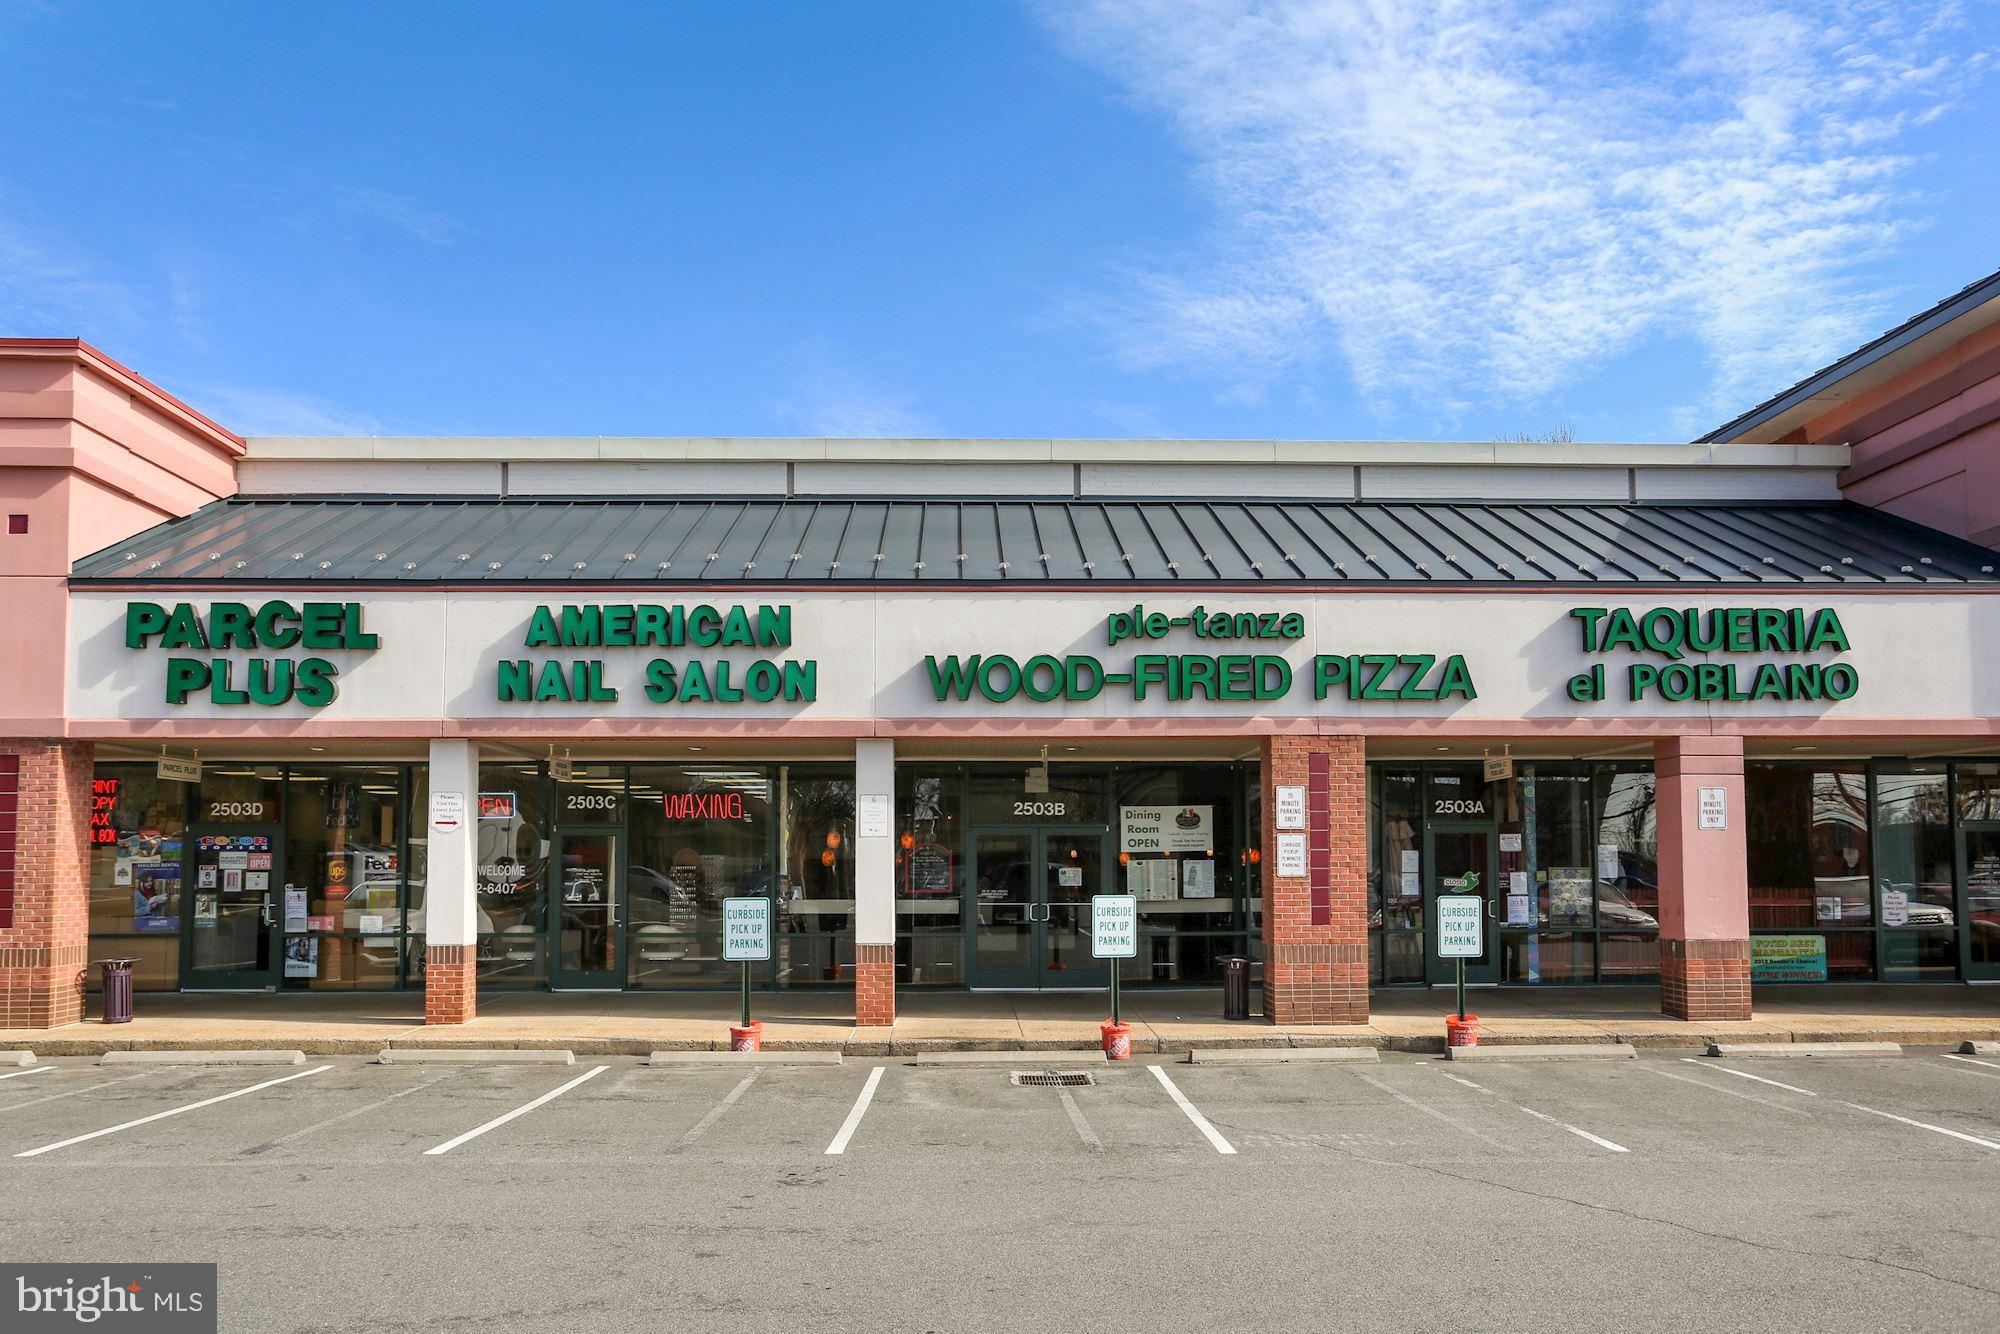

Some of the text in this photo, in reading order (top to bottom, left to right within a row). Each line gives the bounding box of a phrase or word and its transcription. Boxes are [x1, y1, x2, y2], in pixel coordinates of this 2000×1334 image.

[126, 601, 381, 650] PARCEL
[524, 604, 793, 648] AMERICAN
[1109, 604, 1305, 646] pie-tanza
[1570, 607, 1851, 660] TAQUERIA
[165, 657, 339, 707] PLUS
[497, 658, 818, 704] NAIL SALON
[925, 653, 1478, 703] WOOD-FIRED PIZZA
[1567, 663, 1860, 702] el POBLANO
[163, 763, 197, 775] PARCEL PLUS
[91, 779, 118, 794] RINT
[91, 796, 118, 810] OPY
[477, 797, 511, 816] EN
[567, 795, 616, 809] 2503C
[664, 793, 742, 819] WAXING
[1013, 801, 1065, 816] 2503B
[1435, 800, 1485, 814] 2503A
[211, 802, 263, 817] 2503D
[1125, 810, 1161, 822] Dining
[91, 812, 110, 826] AX
[1128, 825, 1159, 834] Room
[200, 836, 268, 846] COLOR
[1128, 838, 1160, 848] OPEN
[249, 859, 271, 868] OPEN
[365, 855, 398, 870] FedE
[329, 866, 346, 879] ups
[477, 865, 526, 876] WELCOME
[727, 909, 765, 920] CURBSIDE
[1096, 906, 1132, 917] CURBSIDE
[1442, 907, 1478, 917] CURBSIDE
[731, 924, 762, 934] PICK UP
[1099, 921, 1129, 932] PICK UP
[1445, 921, 1475, 932] PICK UP
[729, 938, 764, 949] PARKING
[1098, 935, 1130, 946] PARKING
[1444, 936, 1476, 946] PARKING
[1756, 939, 1817, 947] VOTED BEST
